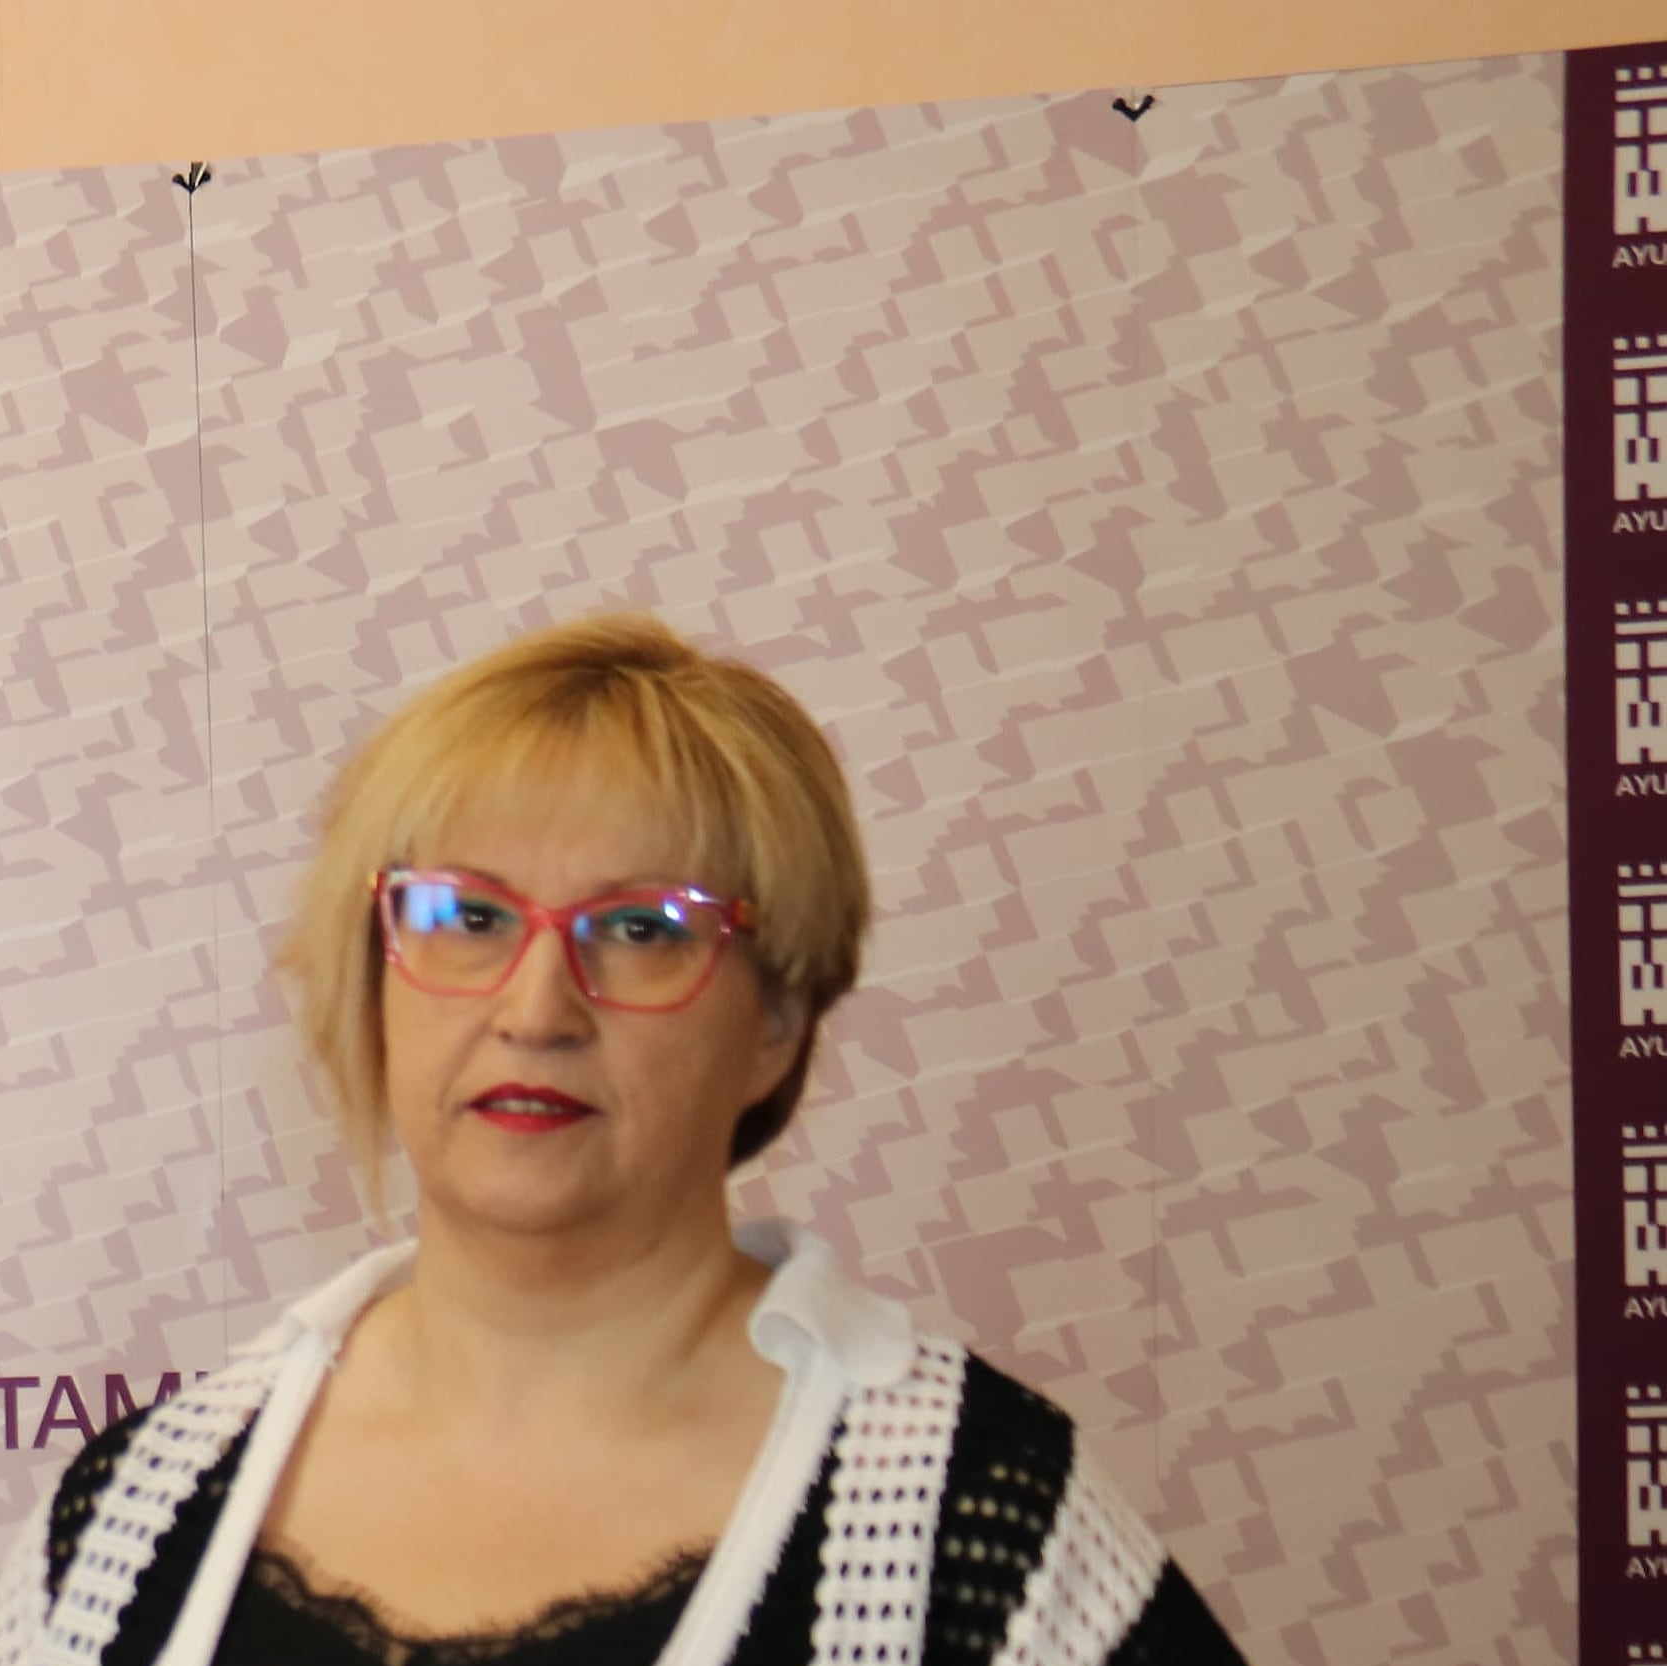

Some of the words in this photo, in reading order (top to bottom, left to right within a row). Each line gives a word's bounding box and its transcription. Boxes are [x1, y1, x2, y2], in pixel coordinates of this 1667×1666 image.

[1612, 244, 1667, 268] AYU
[1612, 510, 1667, 533] AYU
[1615, 774, 1667, 797] AYU
